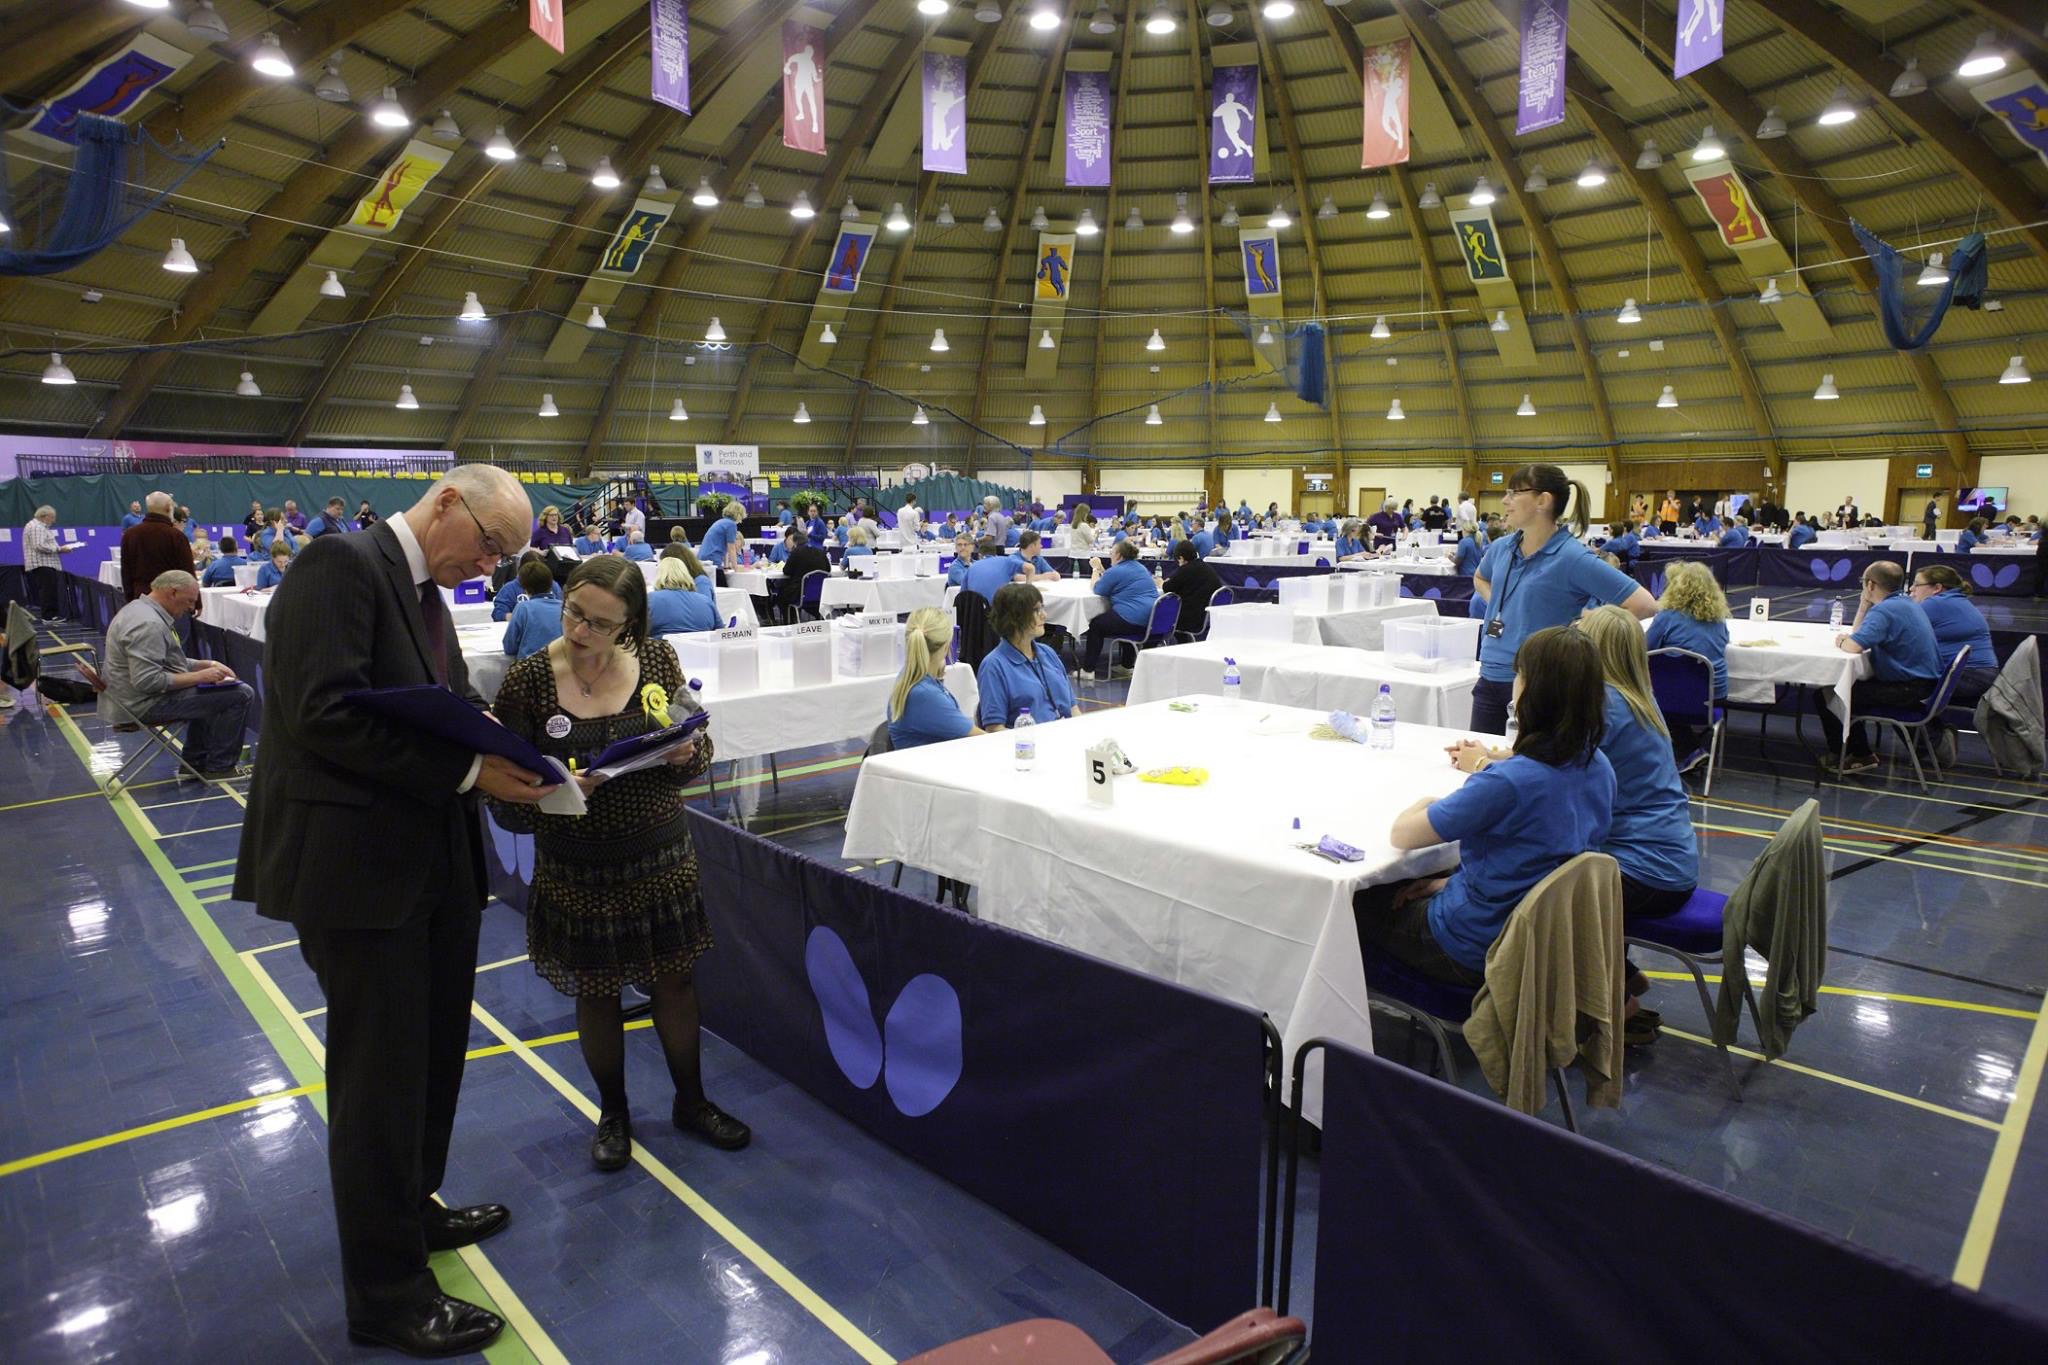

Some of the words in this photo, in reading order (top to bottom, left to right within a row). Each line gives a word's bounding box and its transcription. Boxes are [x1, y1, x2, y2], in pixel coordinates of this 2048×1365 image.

[1075, 127, 1098, 137] Sport
[719, 450, 738, 458] Perth
[739, 450, 752, 458] and
[1755, 604, 1764, 615] 6
[721, 630, 752, 640] REMAIN
[797, 625, 822, 635] LEAVE
[1092, 760, 1106, 785] 5
